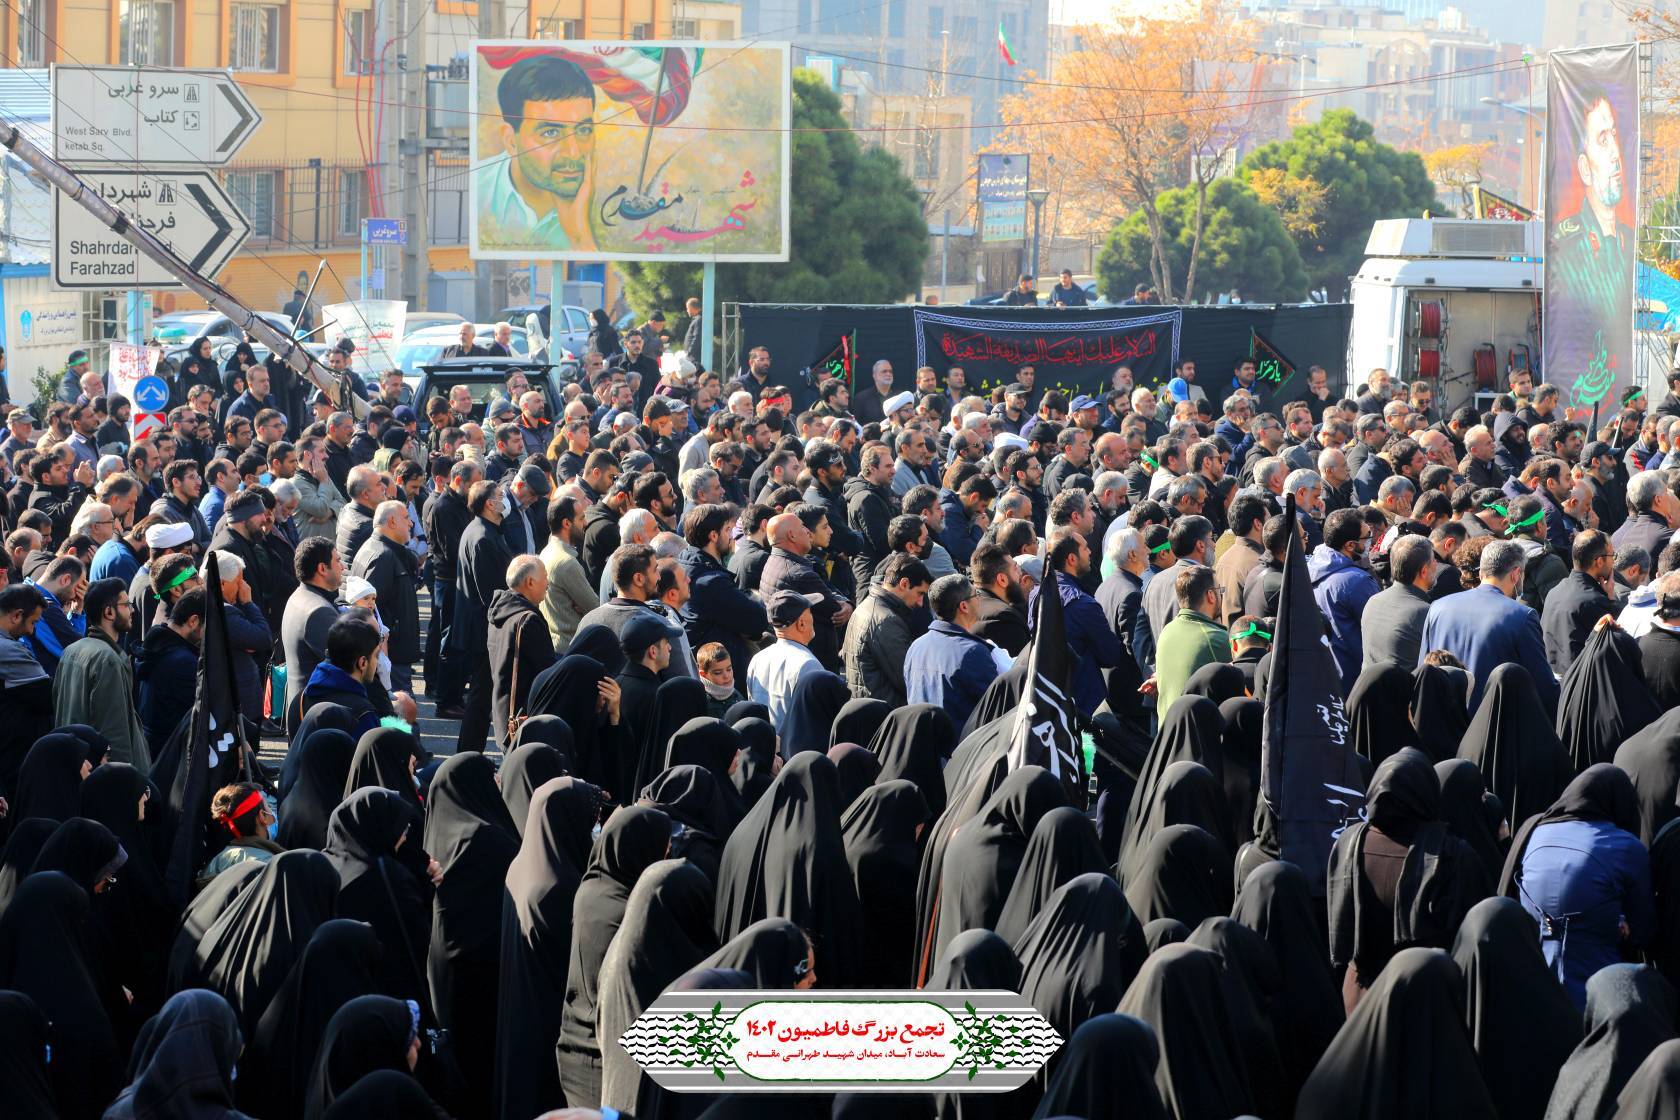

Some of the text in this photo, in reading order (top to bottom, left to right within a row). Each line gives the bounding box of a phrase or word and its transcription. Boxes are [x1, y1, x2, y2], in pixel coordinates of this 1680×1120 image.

[108, 81, 179, 98] سرو غربی
[144, 109, 178, 126] کتاب
[65, 126, 87, 136] West
[70, 261, 135, 275] Farahzad
